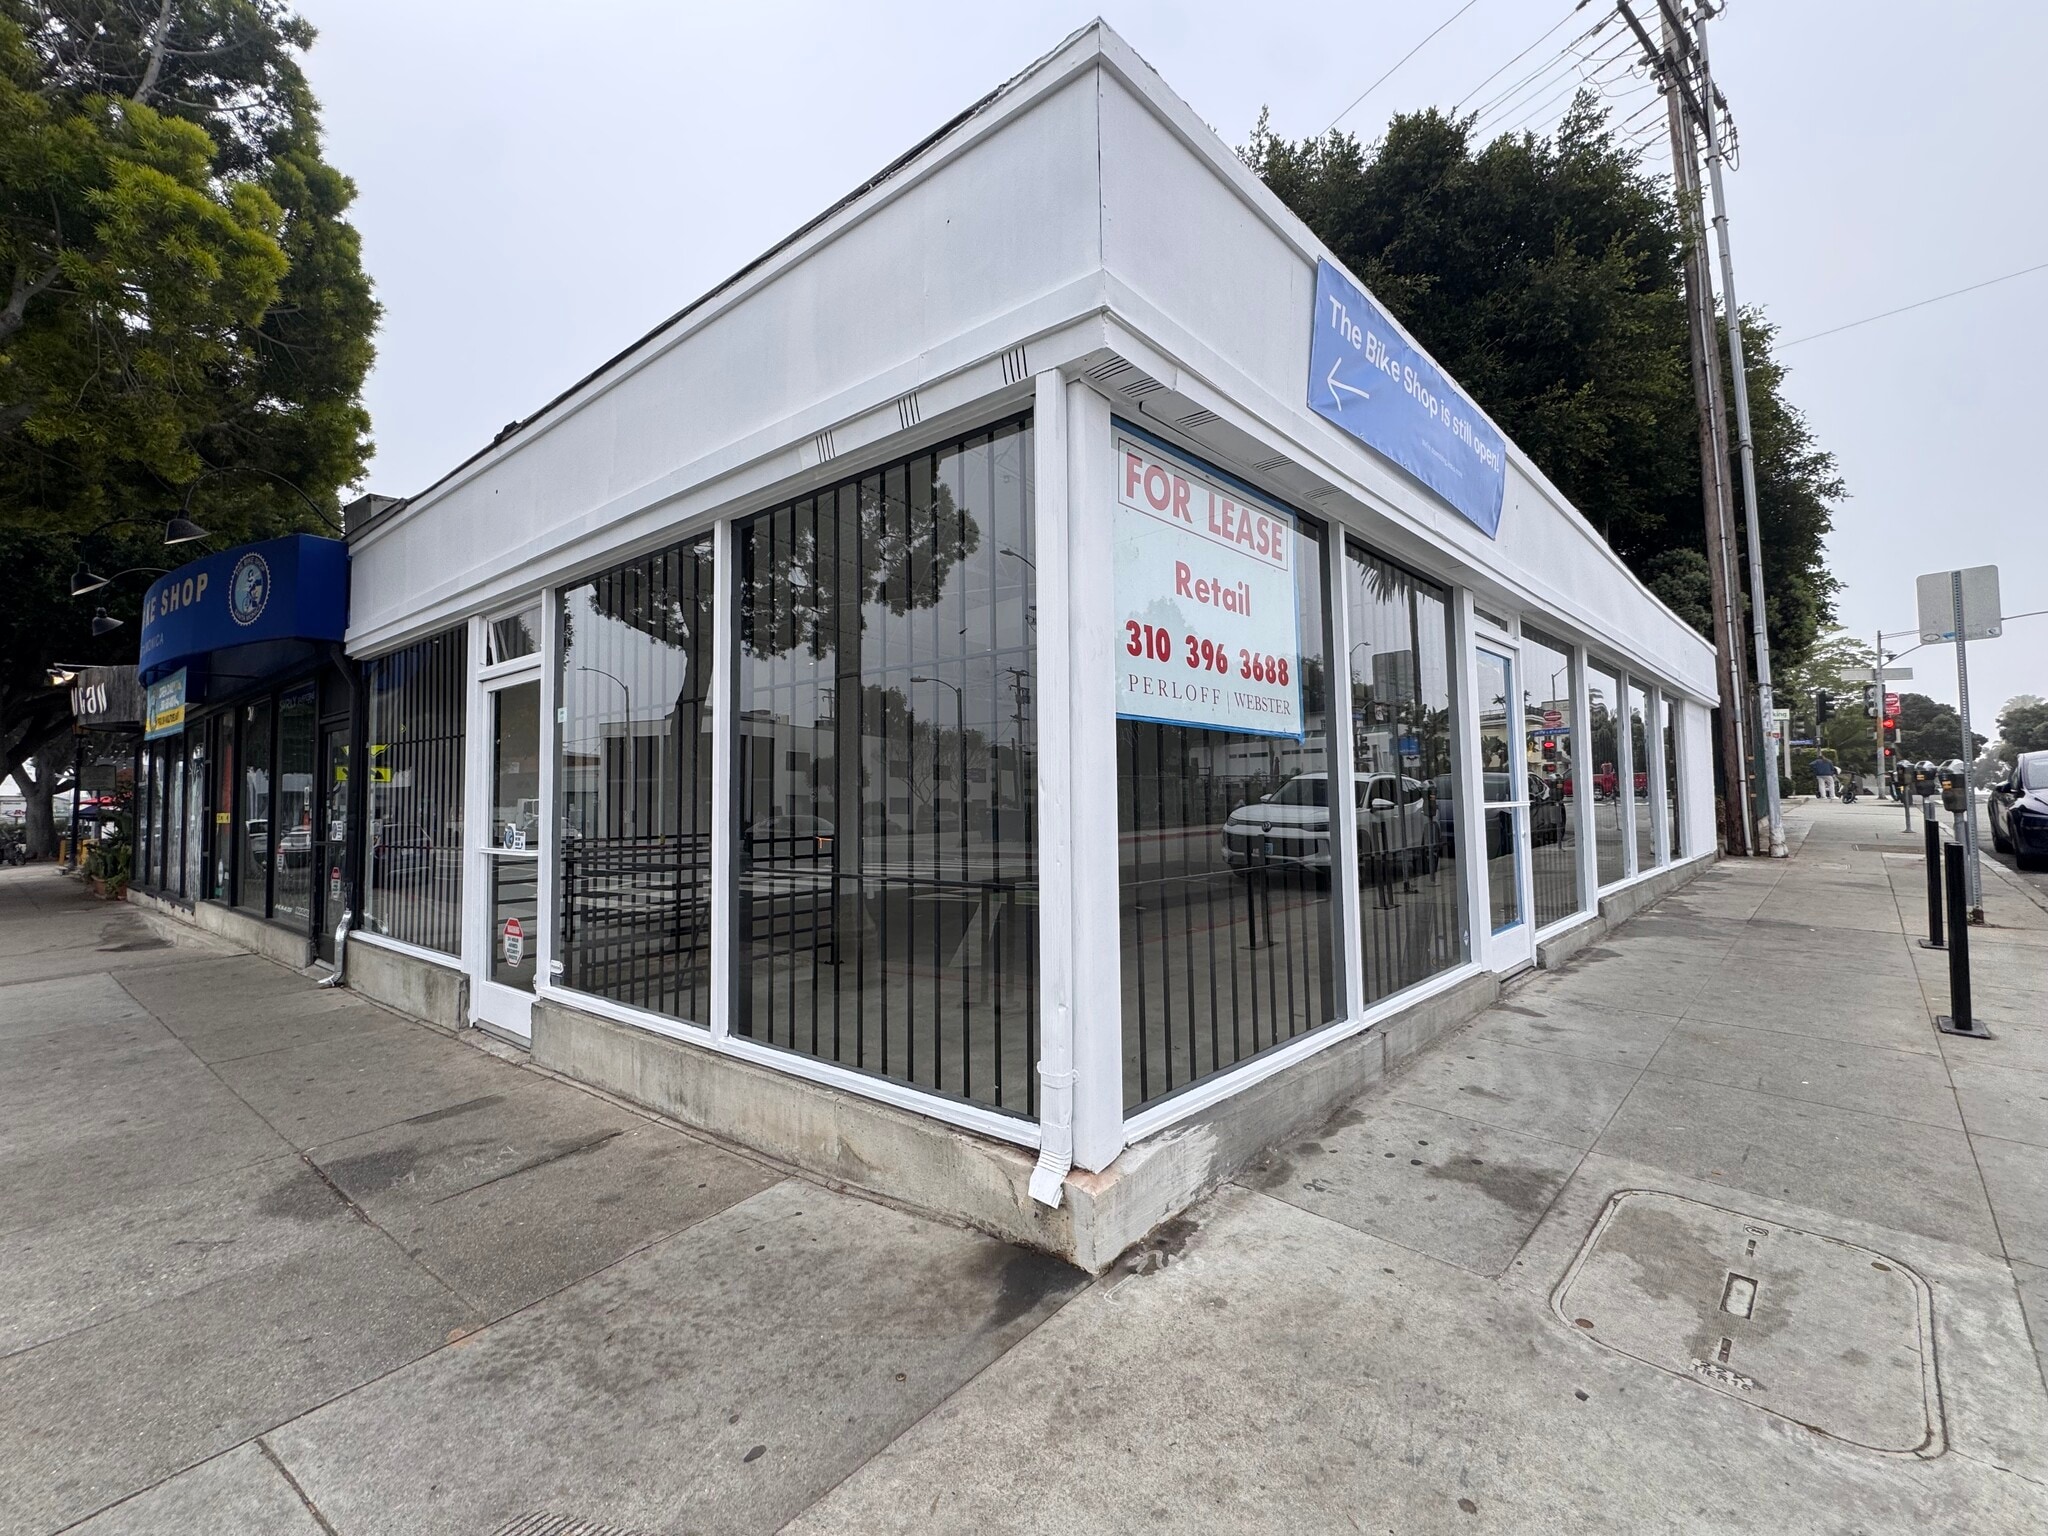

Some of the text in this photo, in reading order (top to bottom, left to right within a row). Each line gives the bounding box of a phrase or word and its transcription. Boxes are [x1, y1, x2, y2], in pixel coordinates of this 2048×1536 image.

[1329, 295, 1362, 350] The
[1365, 330, 1400, 383] Bike
[1404, 366, 1437, 418] Shop
[1441, 399, 1451, 425] is
[1452, 415, 1472, 448] still
[1474, 436, 1499, 474] open!
[1126, 453, 1283, 562] FOR LEASE
[160, 573, 208, 617] SHOP
[1175, 560, 1251, 617] Retail
[1125, 620, 1290, 687] 310 396 3688
[1128, 674, 1291, 715] PERLOFF WEBSTER
